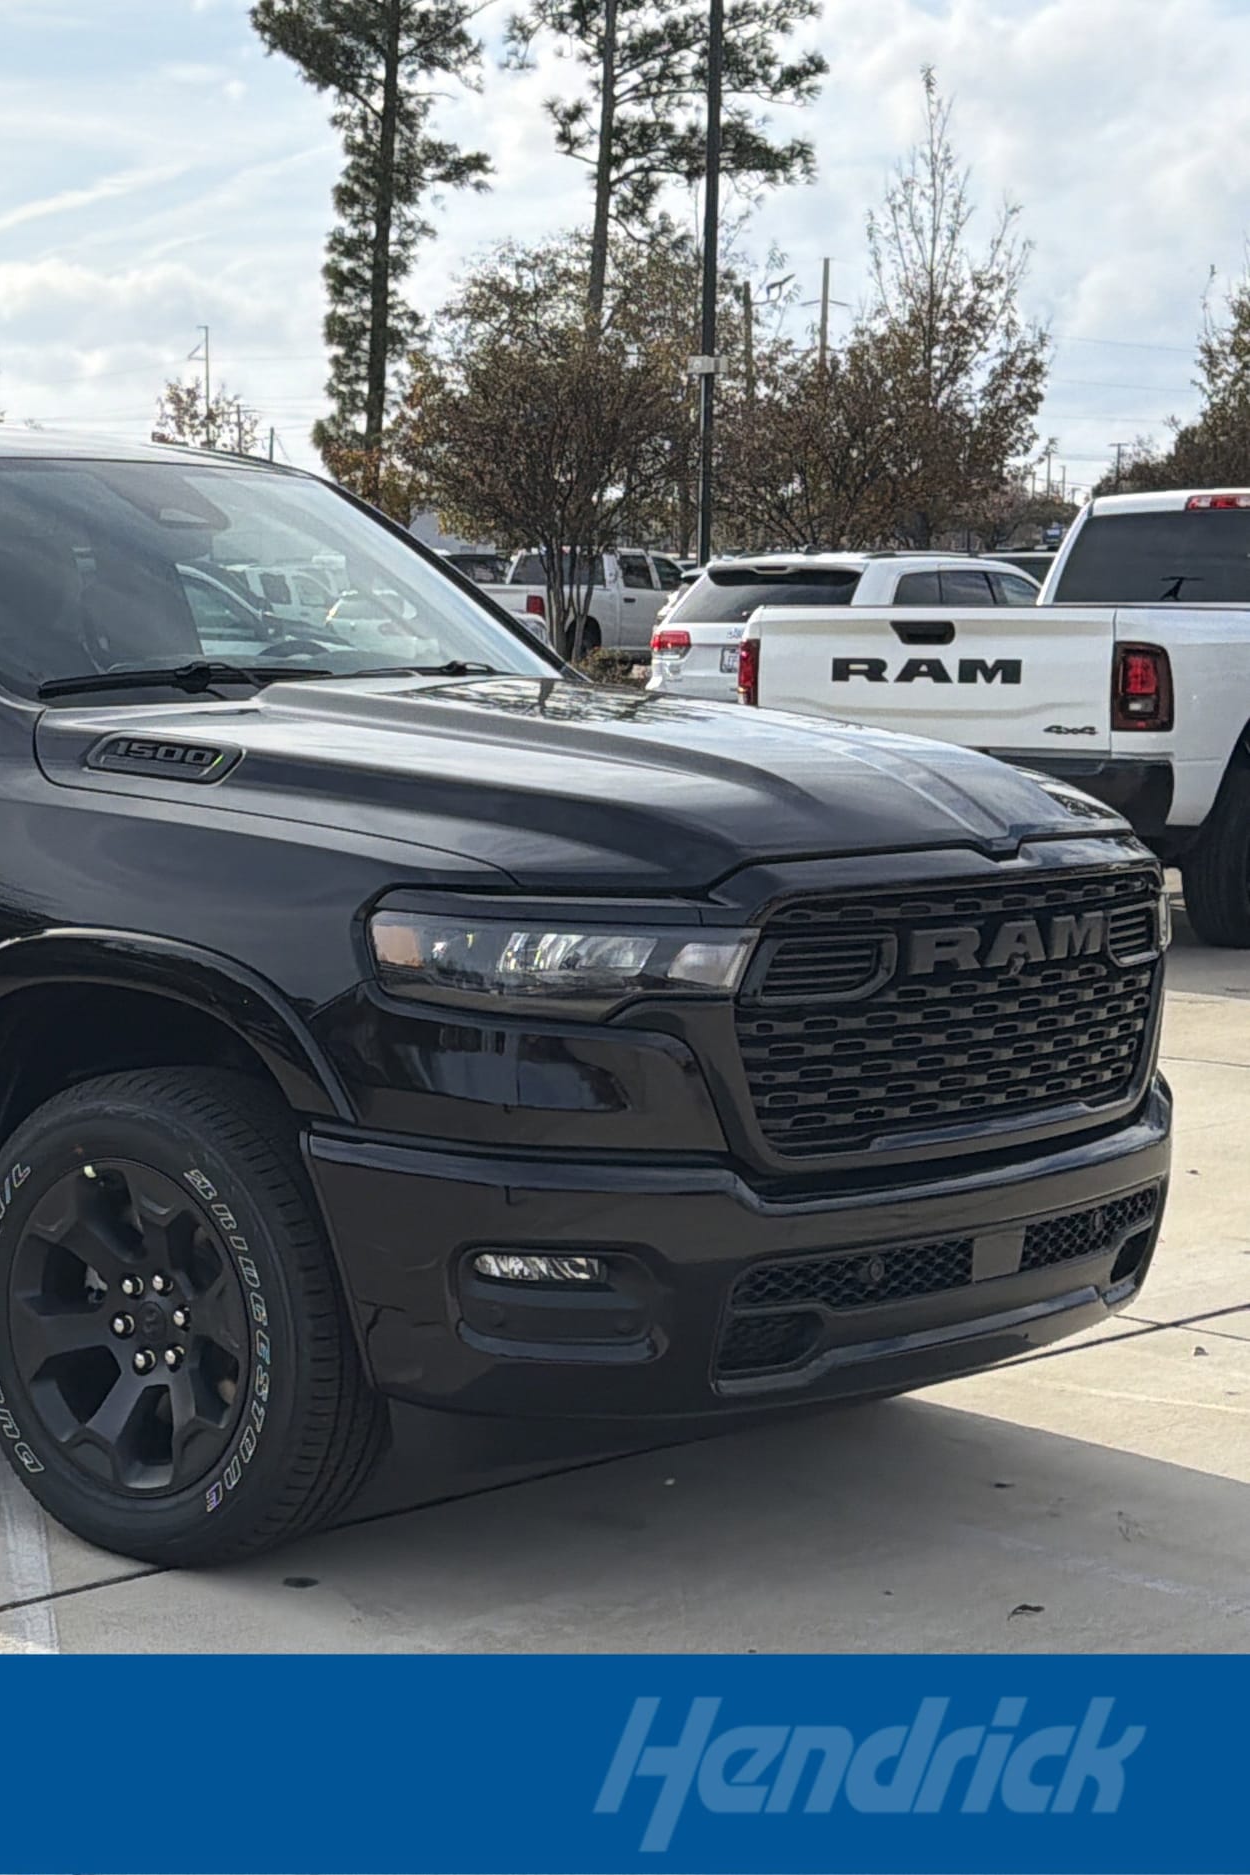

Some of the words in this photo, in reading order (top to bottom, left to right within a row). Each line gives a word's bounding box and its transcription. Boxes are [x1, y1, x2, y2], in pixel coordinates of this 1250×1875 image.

[831, 658, 1023, 685] RAM
[1043, 724, 1097, 736] 4x4
[114, 739, 216, 766] 1500
[907, 910, 1105, 976] RAM
[183, 1167, 271, 1513] BRIDGESTONE
